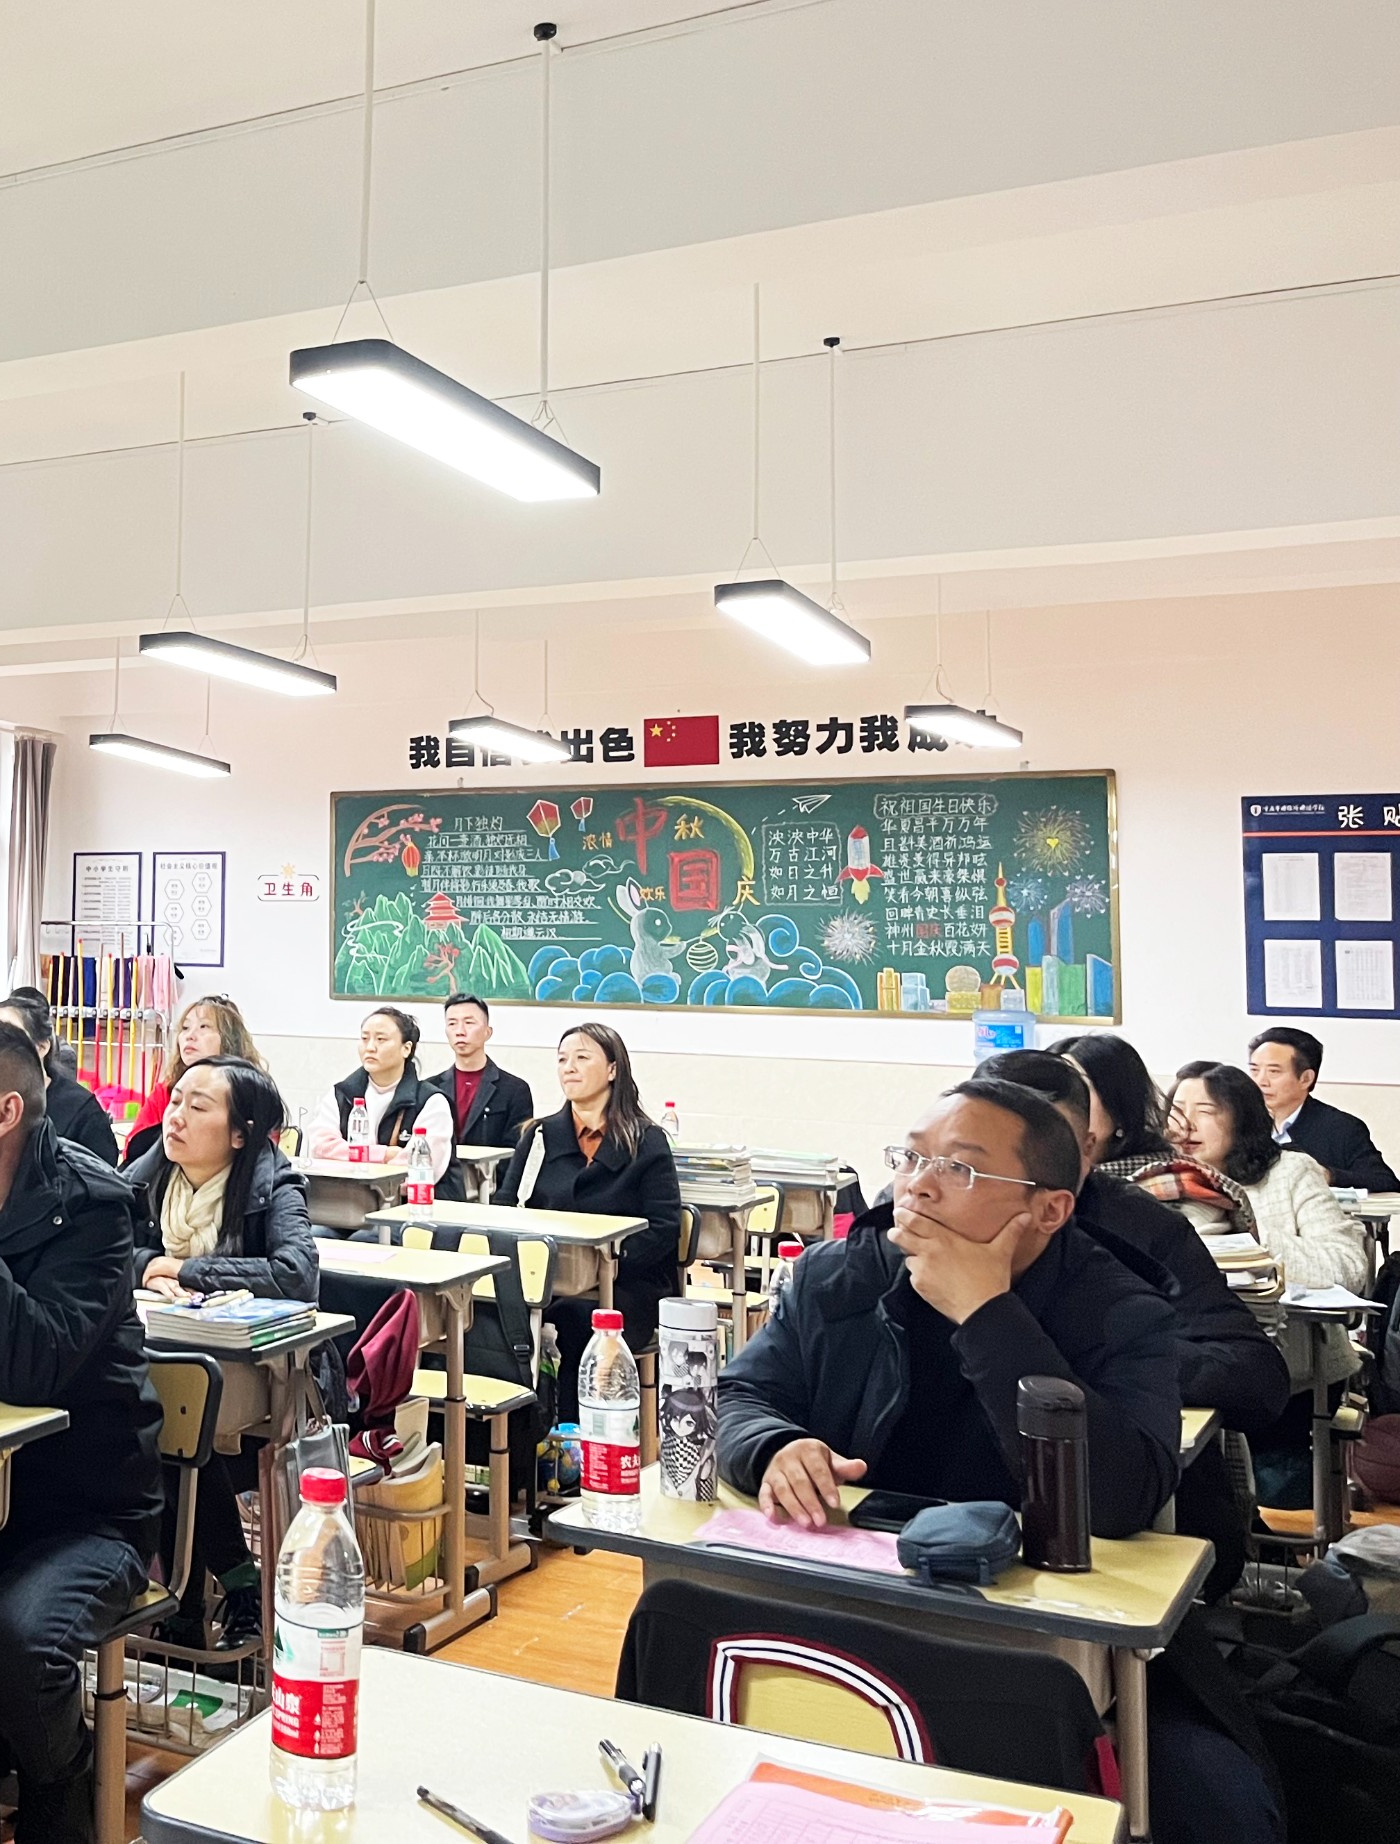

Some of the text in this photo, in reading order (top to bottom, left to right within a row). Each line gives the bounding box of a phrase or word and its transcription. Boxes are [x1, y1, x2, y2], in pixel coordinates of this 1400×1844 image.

[409, 710, 997, 769] 我自出色 我努力我成
[879, 796, 992, 815] 祝祖国生日快乐
[881, 816, 989, 834] 华夏昌平万万年
[583, 832, 613, 850] 浓情
[768, 828, 834, 845] 泱泱中华
[769, 846, 837, 862] 万古江河
[768, 864, 833, 881] 如日之升
[263, 882, 314, 897] 卫生角
[639, 886, 666, 901] 欢乐
[770, 884, 841, 901] 如月之恒
